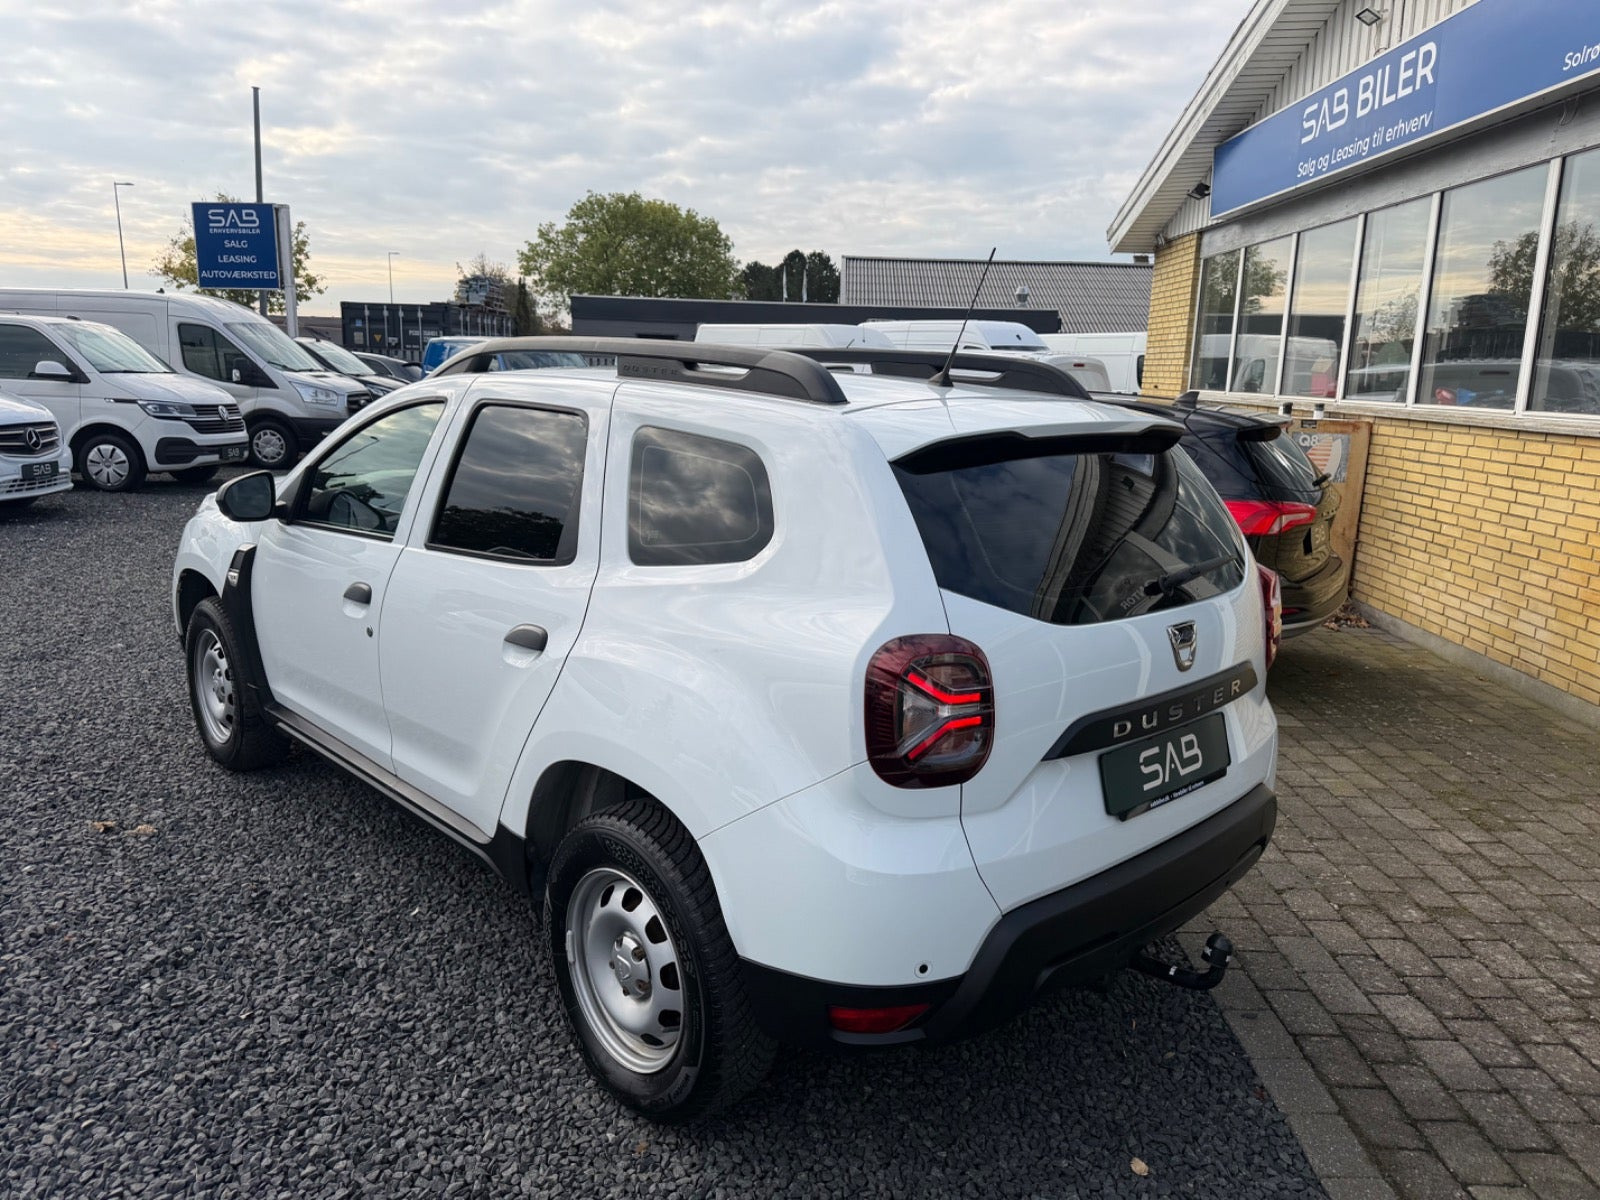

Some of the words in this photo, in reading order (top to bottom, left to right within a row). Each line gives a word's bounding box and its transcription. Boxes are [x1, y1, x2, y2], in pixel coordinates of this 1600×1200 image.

[1301, 87, 1349, 144] SAB
[1356, 41, 1437, 119] BILER
[1296, 157, 1316, 178] Salg
[1317, 153, 1330, 171] og
[1331, 138, 1370, 164] Leasing
[1372, 126, 1385, 148] til
[1385, 111, 1433, 142] erhverv
[207, 209, 260, 227] SAB
[224, 240, 248, 248] SALG
[218, 255, 256, 263] LEASING
[201, 270, 277, 279] AUTOVÆRKSTED
[1299, 434, 1319, 447] Q8
[33, 463, 52, 476] SAB
[1113, 679, 1242, 739] DUSTER
[1138, 733, 1203, 791] SAB
